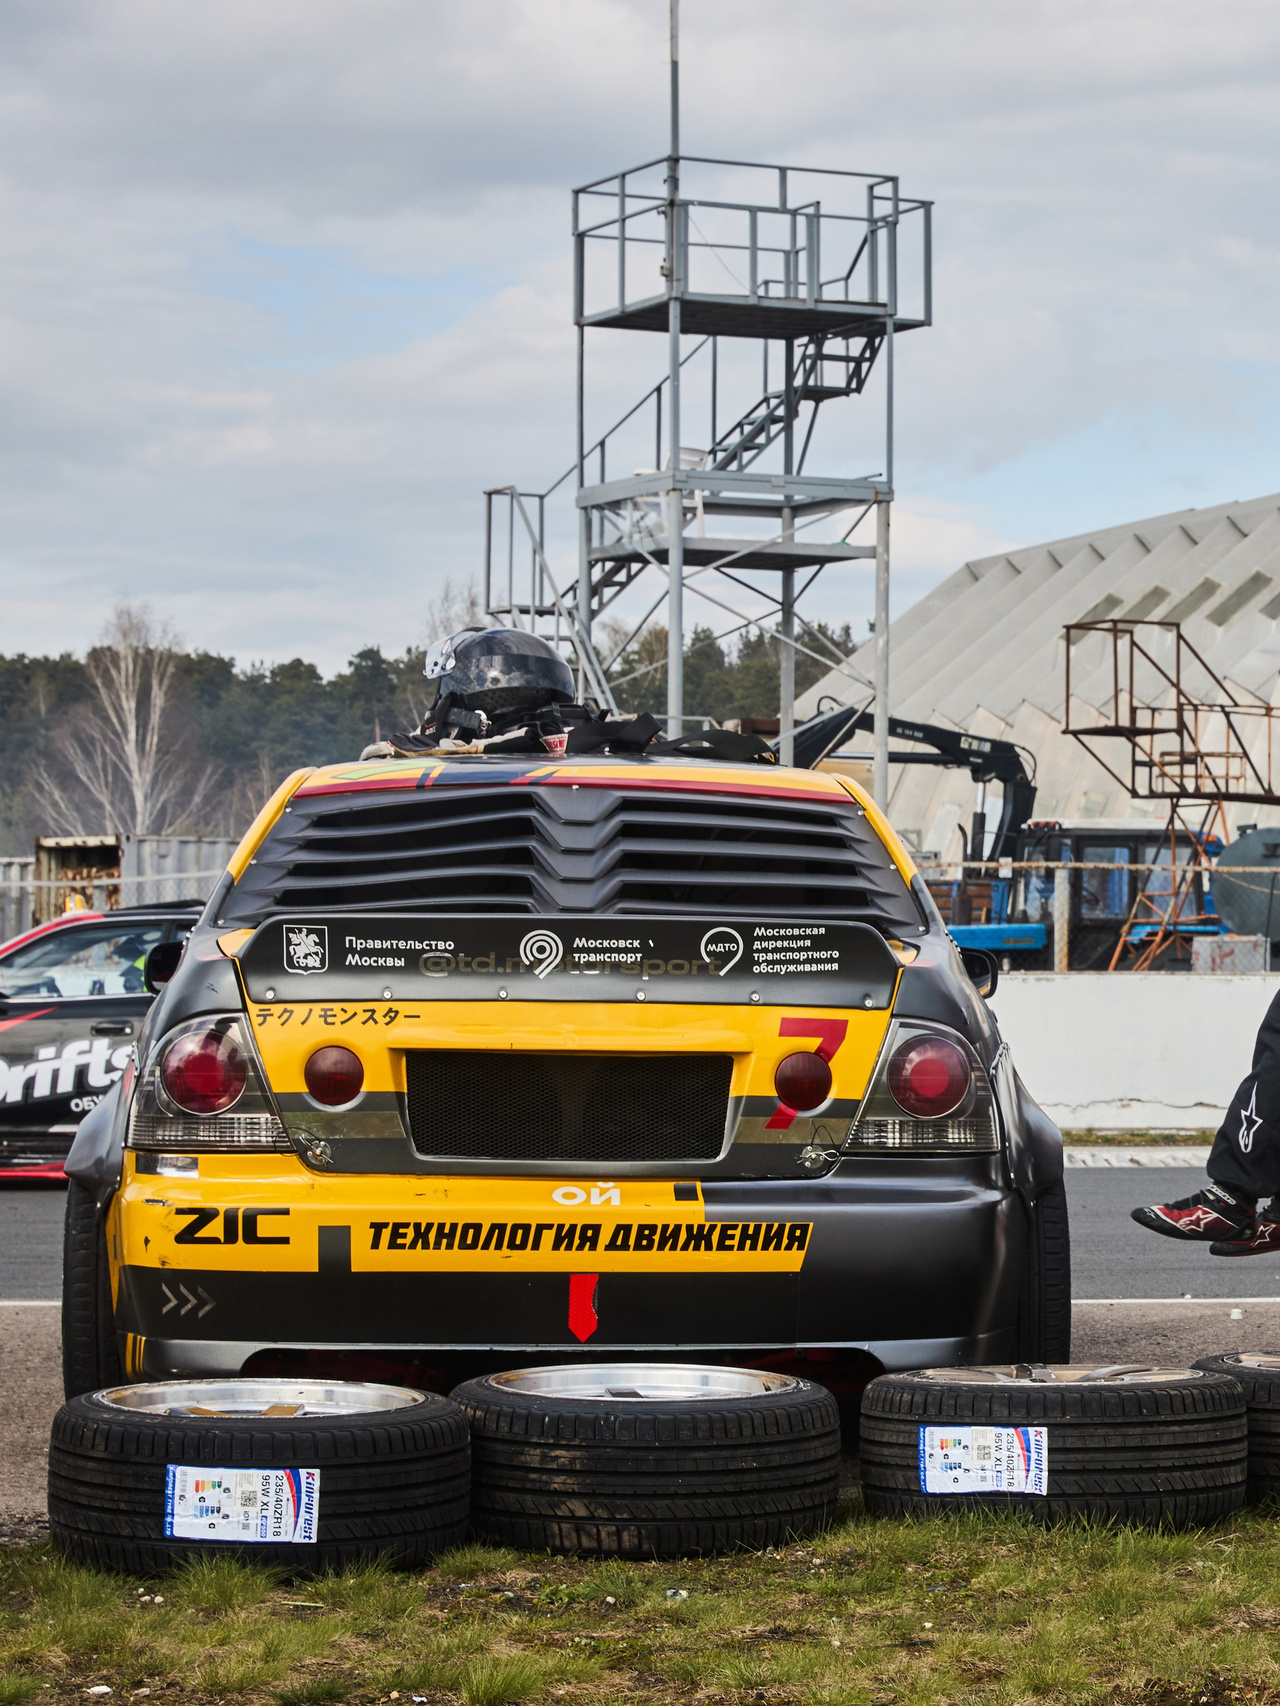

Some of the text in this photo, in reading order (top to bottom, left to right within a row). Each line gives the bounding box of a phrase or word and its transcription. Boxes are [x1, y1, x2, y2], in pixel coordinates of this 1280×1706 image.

[753, 926, 826, 938] Московская
[345, 936, 455, 951] Правительство
[572, 937, 655, 949] Московск
[752, 938, 812, 950] дирекция
[345, 953, 405, 968] Москвы
[572, 951, 643, 965] транспорт
[752, 949, 840, 962] транспортного
[752, 961, 839, 974] обслуживания
[255, 1006, 422, 1027] テクノモンスター
[0, 1038, 133, 1104] rifts
[174, 1207, 290, 1245] ZIC
[368, 1221, 810, 1252] ТЕХНОЛОГИЯ ДВИЖЕНИЯ
[994, 1432, 1003, 1454] 95W
[994, 1457, 1003, 1470] XL
[261, 1474, 271, 1498] 95W
[260, 1500, 270, 1515] XL
[272, 1474, 284, 1537] 235/40ZR18
